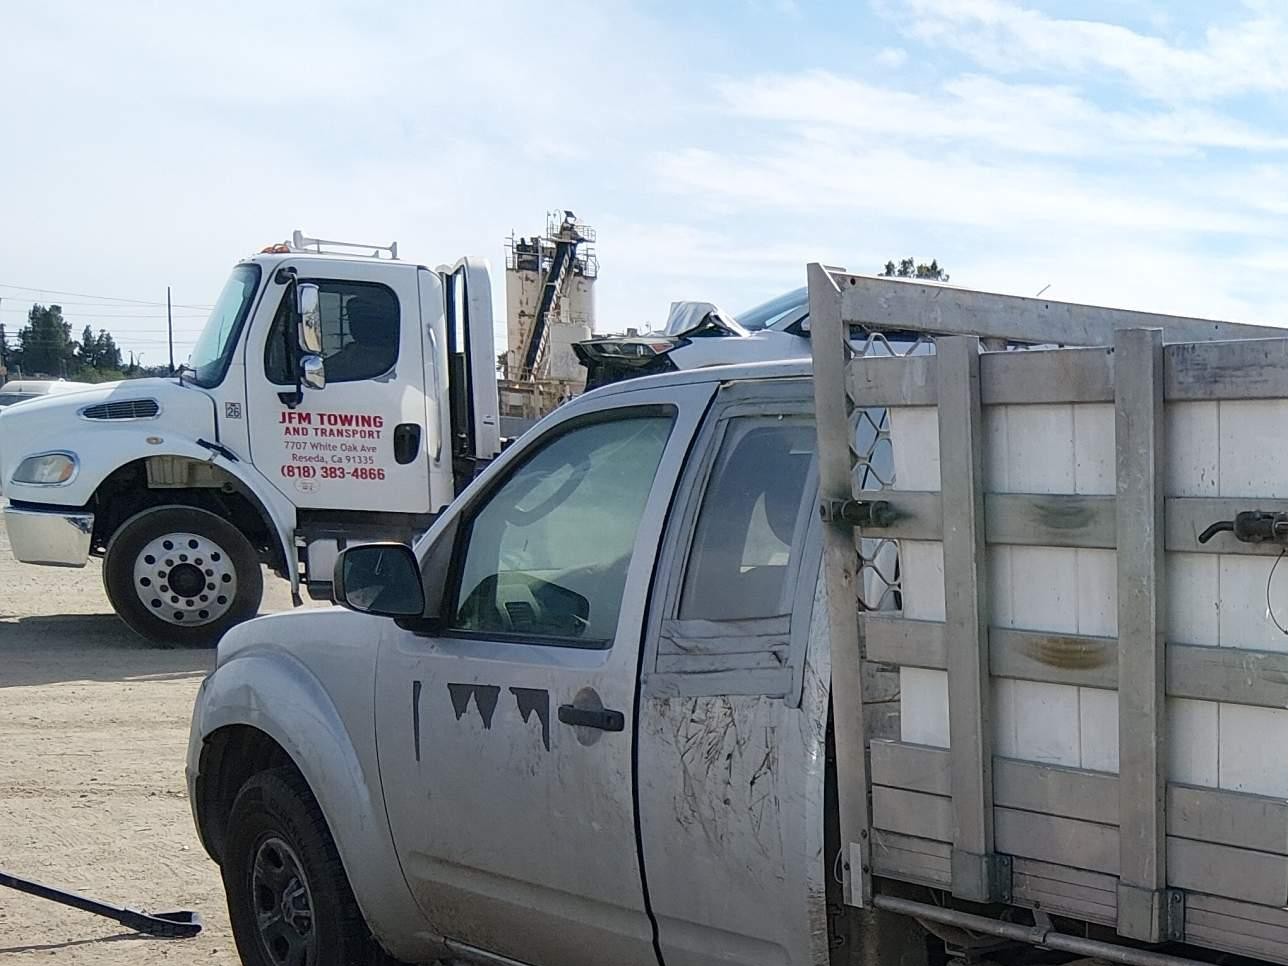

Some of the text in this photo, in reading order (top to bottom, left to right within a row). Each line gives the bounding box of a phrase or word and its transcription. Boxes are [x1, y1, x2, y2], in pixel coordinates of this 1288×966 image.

[227, 406, 241, 417] 26
[279, 411, 384, 428] JFM TOWING
[284, 426, 381, 439] AND TRANSPORT
[284, 441, 377, 452] 7707 White Oak Ave
[291, 453, 374, 465] Reseda, Ca 91335
[280, 465, 385, 480] (818) 383-4866
